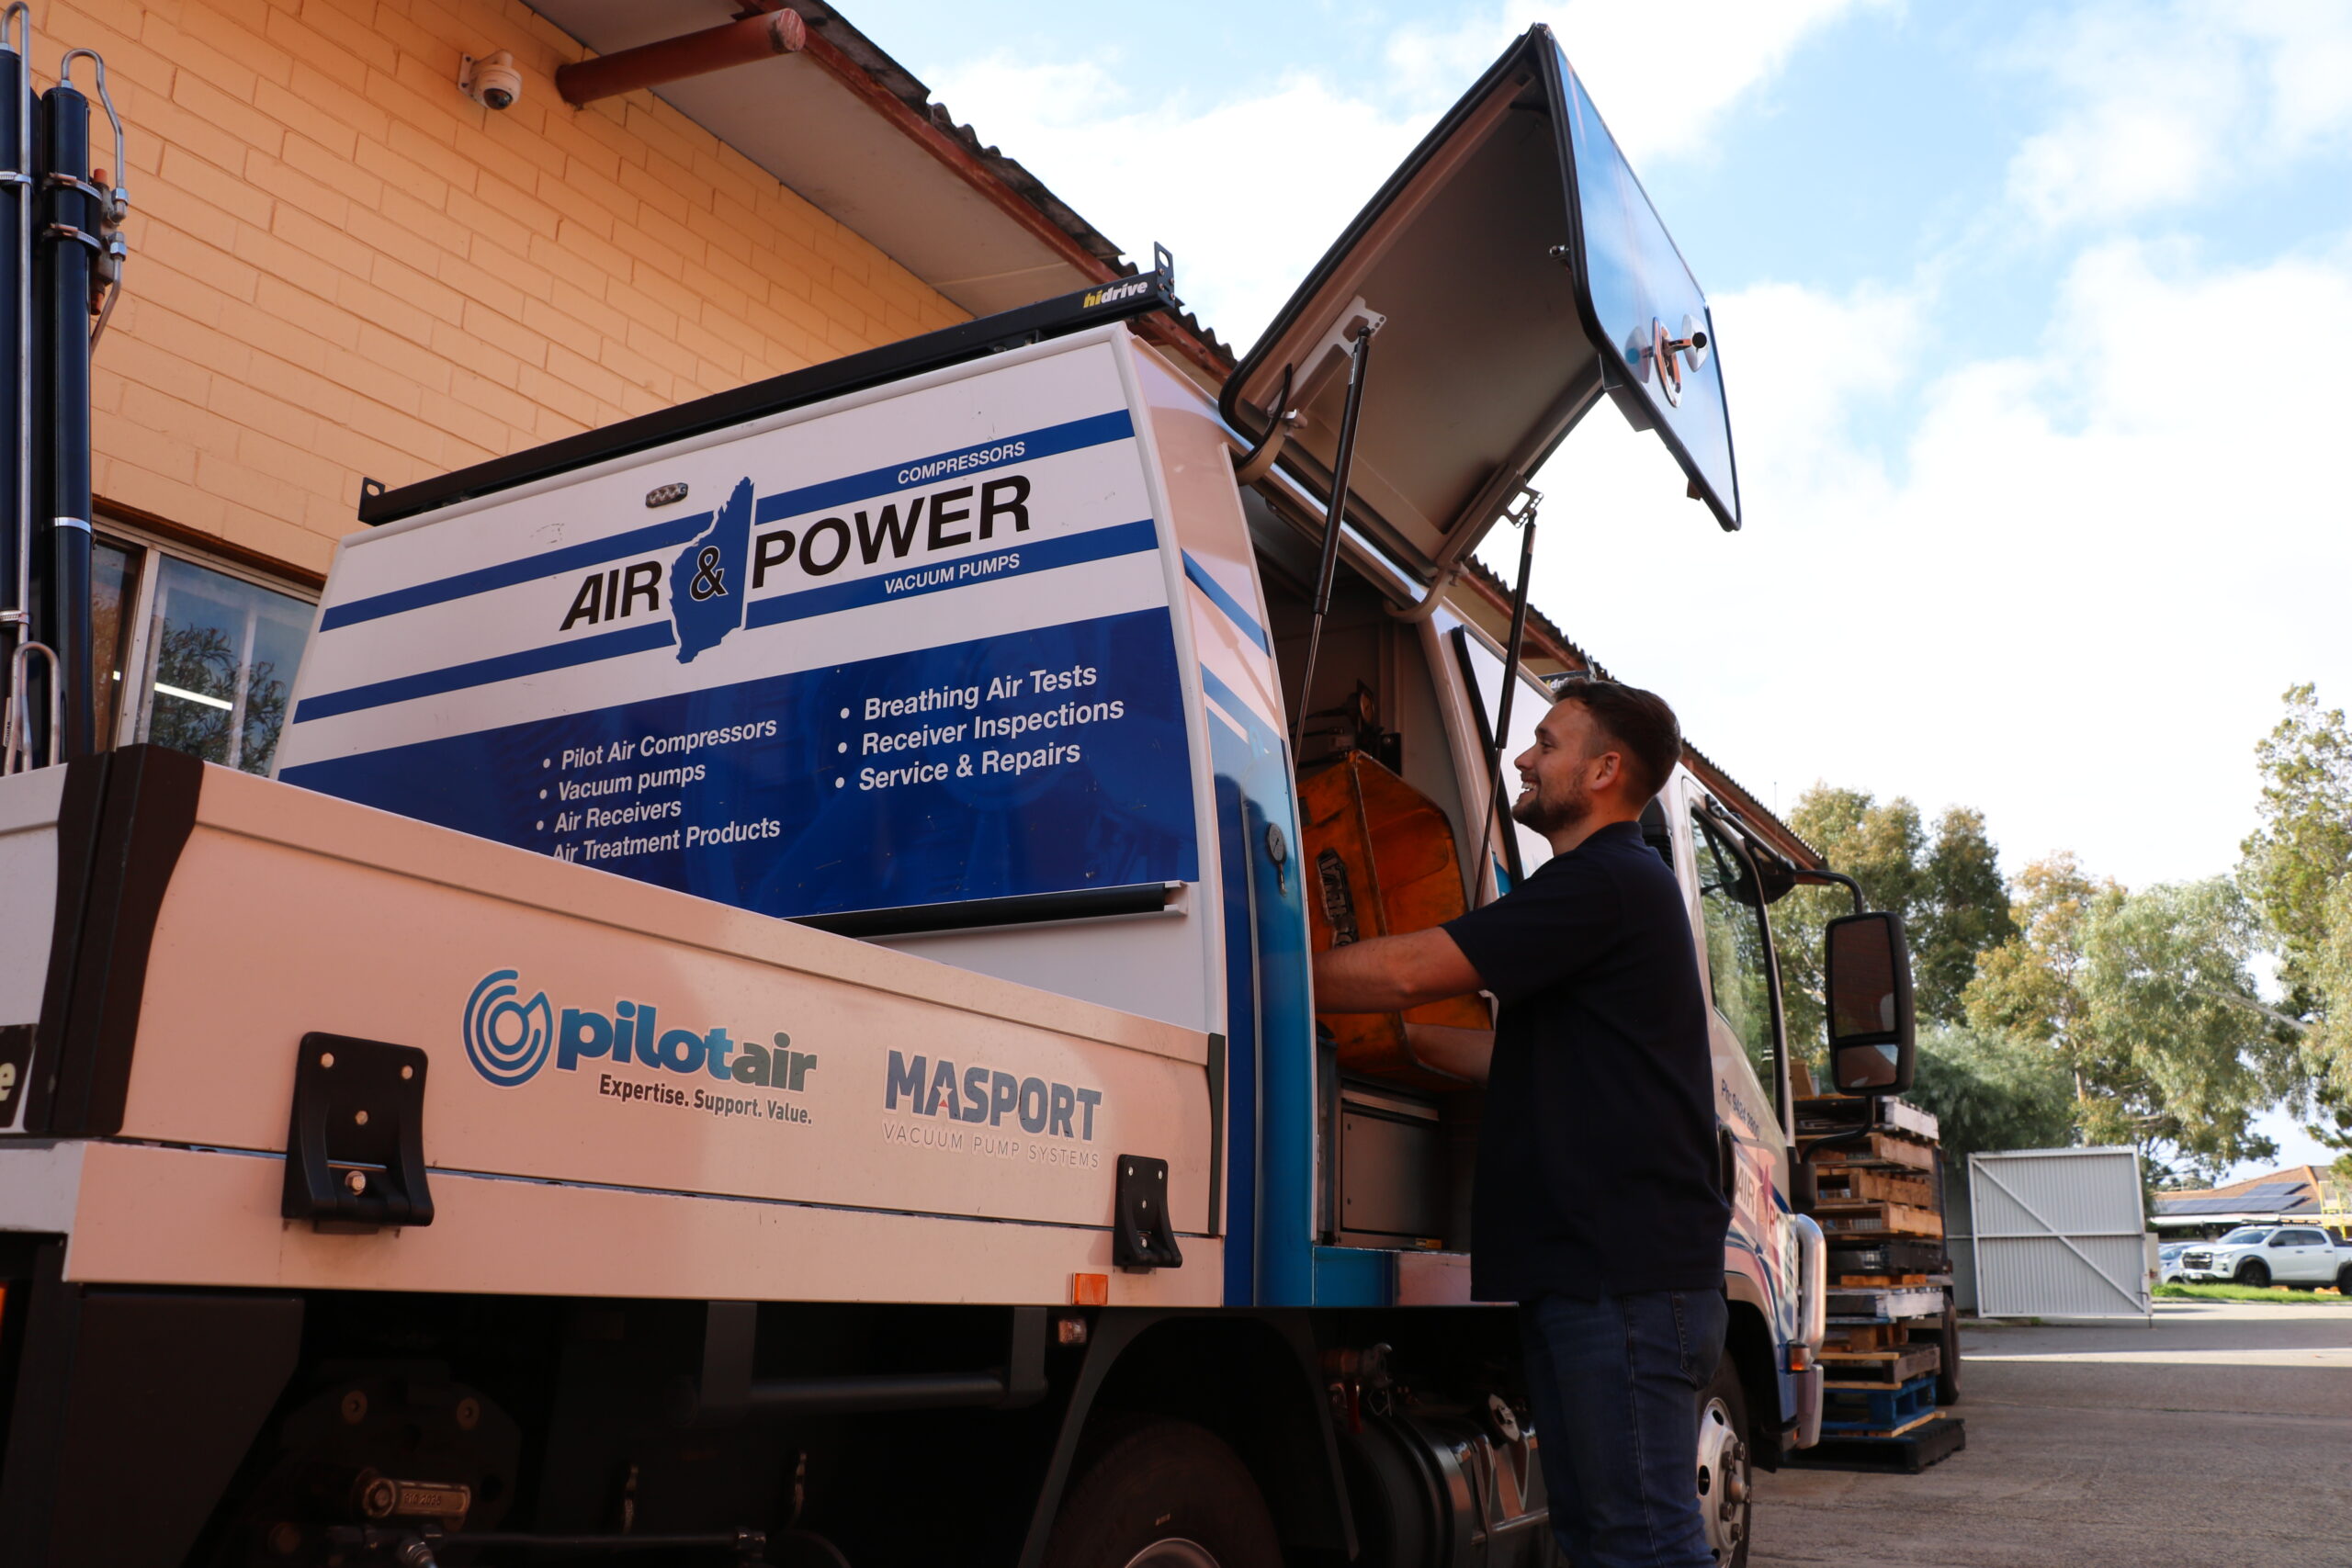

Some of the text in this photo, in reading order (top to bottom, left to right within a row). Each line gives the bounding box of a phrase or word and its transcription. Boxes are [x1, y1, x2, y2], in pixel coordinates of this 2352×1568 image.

[1083, 281, 1148, 308] hidrive
[898, 441, 1025, 485] COMPRESSORS
[560, 474, 1031, 632] AIR & POWER
[884, 553, 1021, 595] VACUUM PUMPS
[864, 663, 1097, 722] Breathing Air Tests
[561, 719, 777, 771] Pilot Air Compressors
[862, 699, 1125, 756] Receiver Inspections
[559, 763, 706, 802] Vacuum pumps
[859, 740, 1080, 791] Service & Repairs
[555, 798, 682, 834] Air Receivers
[553, 817, 781, 863] Air Treatment Products
[599, 1074, 812, 1124] Expertise. Support. Value.
[886, 1050, 1102, 1141] MASPORT
[884, 1123, 1099, 1168] VACUUM PUMP SYSTEMS
[1736, 1168, 1755, 1213] AIR
